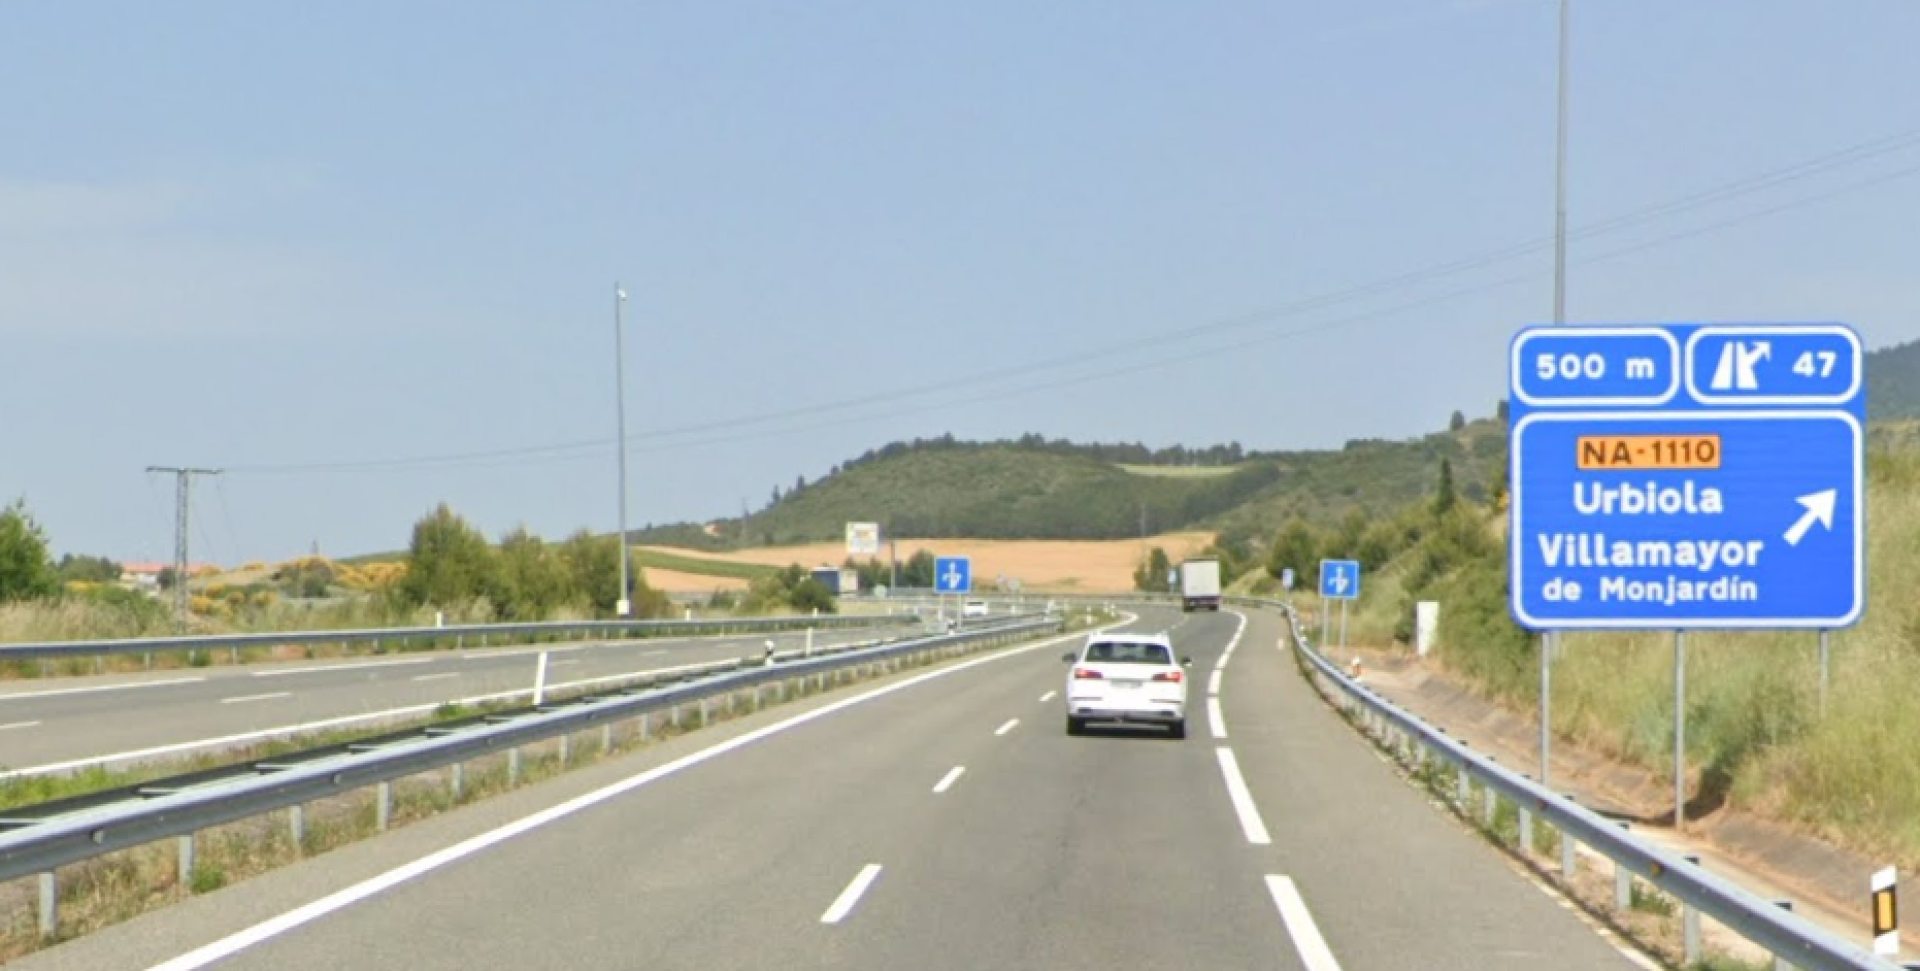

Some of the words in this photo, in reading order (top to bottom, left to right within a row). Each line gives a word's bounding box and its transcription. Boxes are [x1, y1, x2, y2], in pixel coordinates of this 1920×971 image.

[1536, 353, 1606, 380] 500
[1625, 356, 1655, 379] m
[1791, 350, 1838, 378] 47
[1582, 440, 1716, 465] NA-1110
[1573, 479, 1723, 514] Urbiola
[1537, 533, 1764, 572] Villamayor
[1542, 576, 1582, 602] de
[1599, 574, 1758, 606] Monjardín
